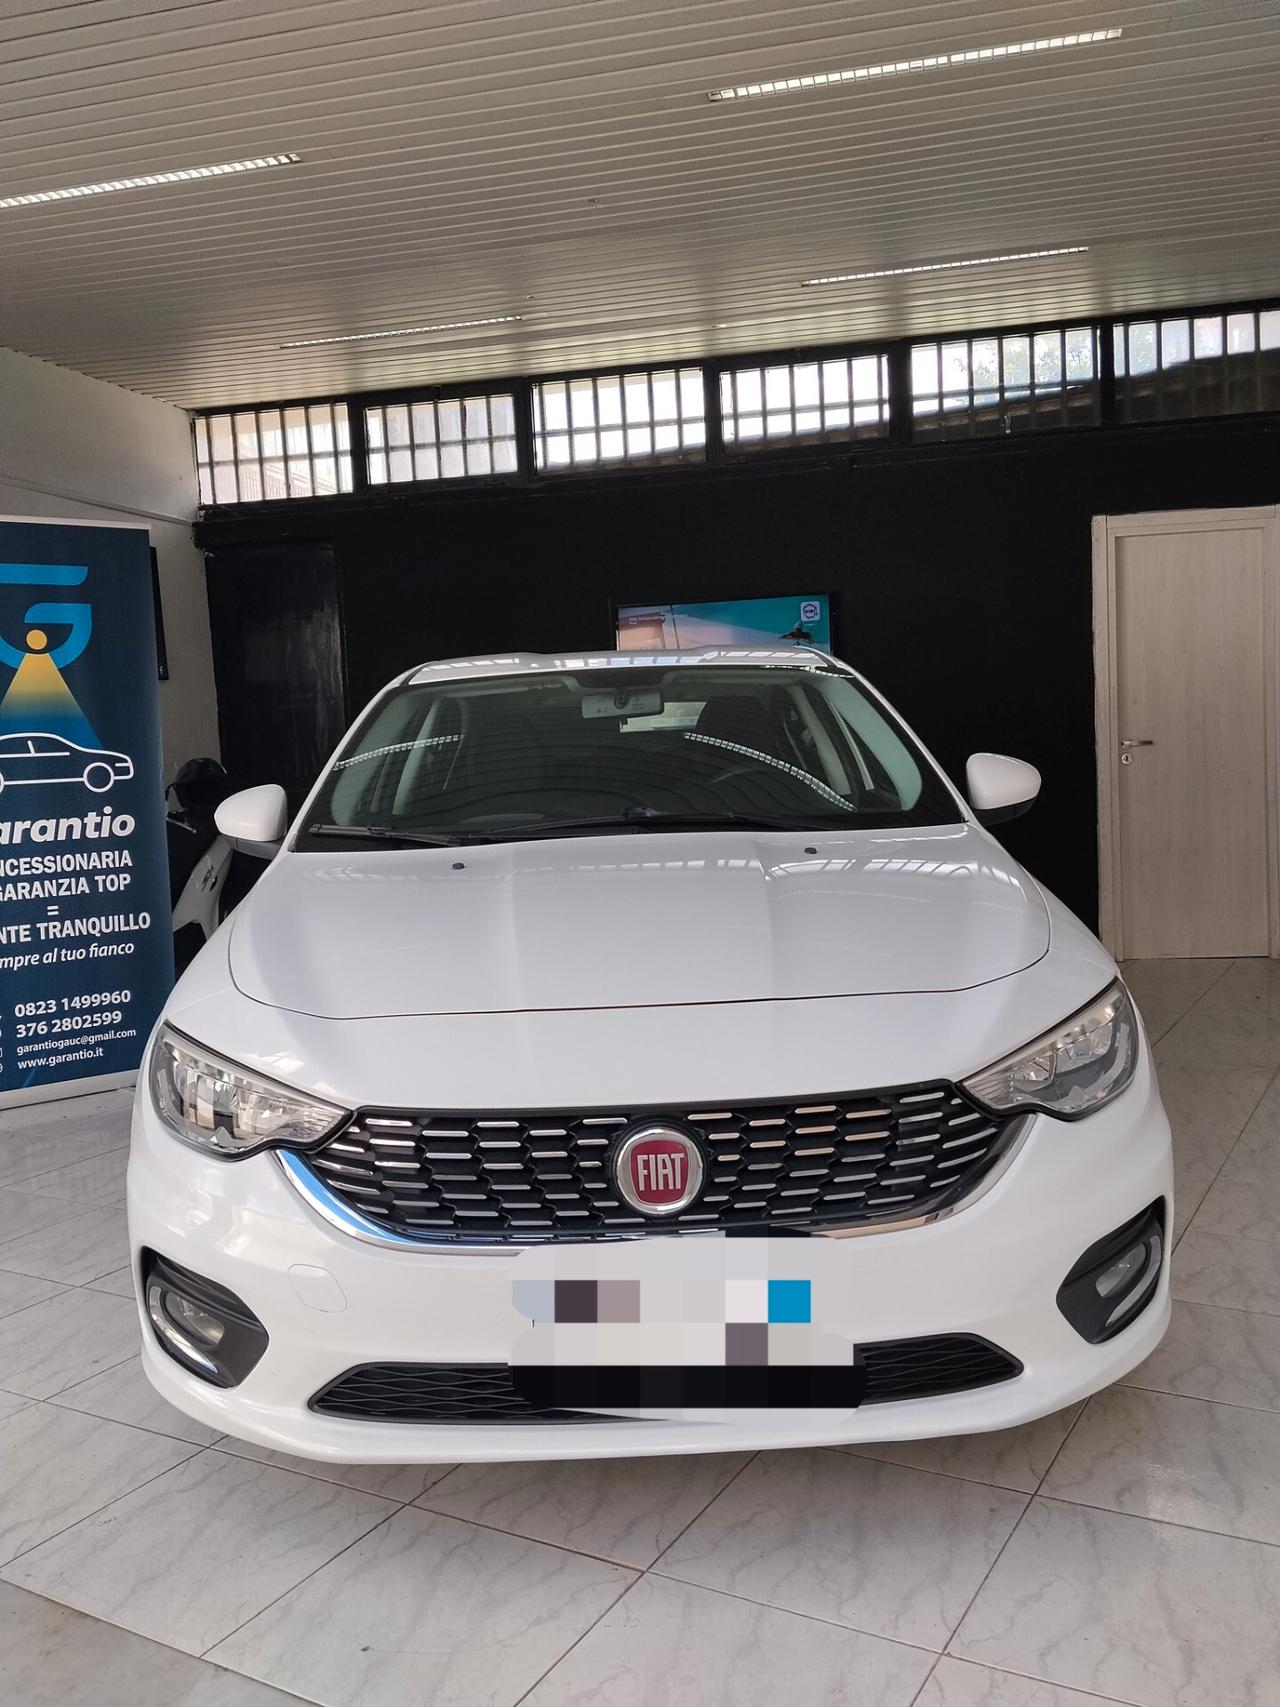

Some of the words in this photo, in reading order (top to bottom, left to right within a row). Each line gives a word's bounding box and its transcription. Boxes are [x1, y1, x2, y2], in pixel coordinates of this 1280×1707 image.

[0, 877, 89, 902] ARANZIA
[95, 873, 131, 893] TOP
[36, 912, 151, 940] TRANQUILLO
[43, 947, 58, 964] al
[61, 947, 87, 961] tuo
[89, 942, 135, 958] fianco
[15, 1000, 57, 1018] 0823
[61, 990, 131, 1011] 1499960
[16, 1021, 48, 1038] 376
[51, 1011, 122, 1033] 2802599
[17, 1029, 137, 1056] garantiogauc@gmail.com
[18, 1047, 104, 1069] www.garantio.it
[637, 1153, 684, 1191] FIAT
